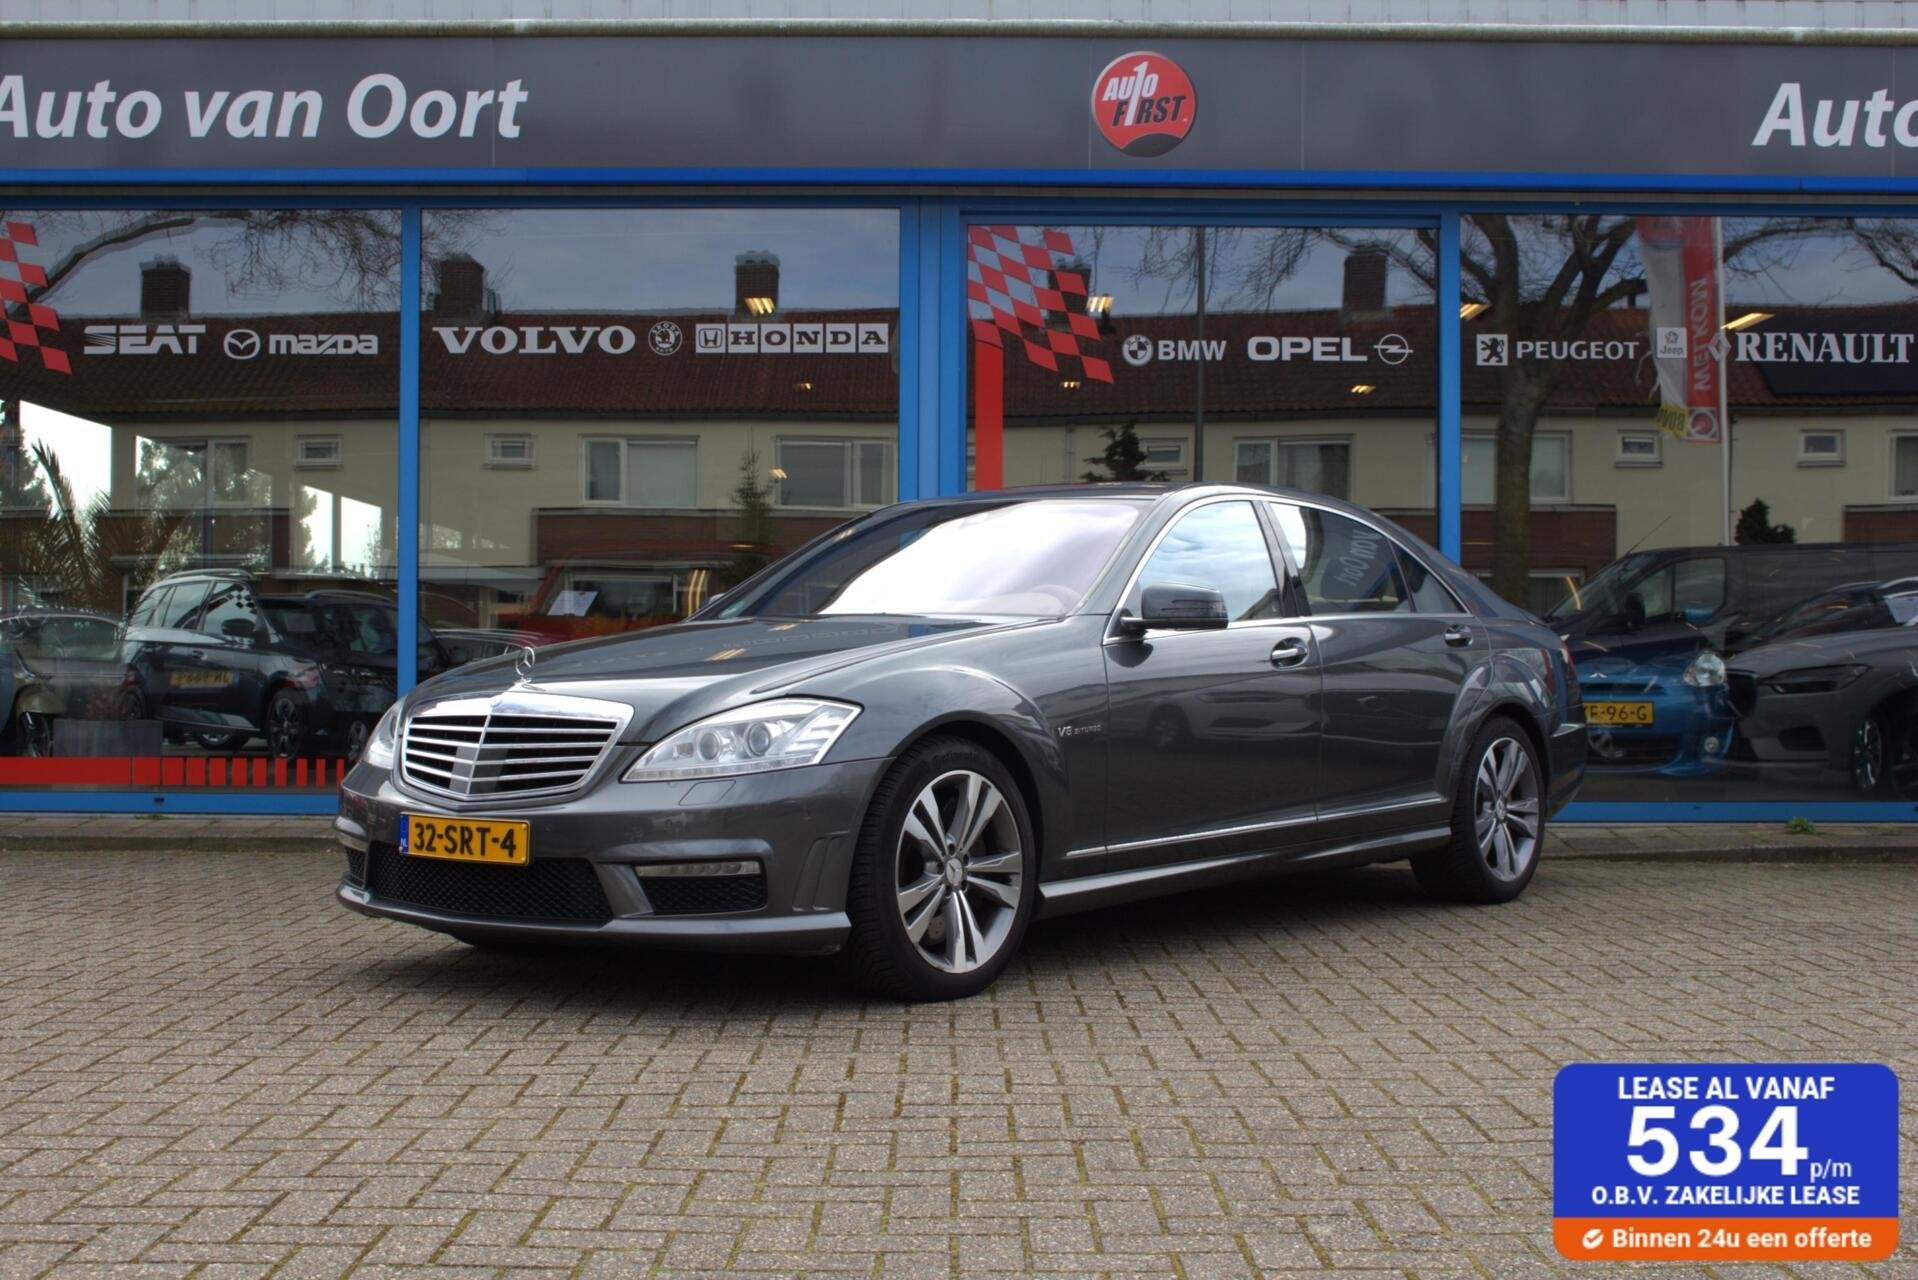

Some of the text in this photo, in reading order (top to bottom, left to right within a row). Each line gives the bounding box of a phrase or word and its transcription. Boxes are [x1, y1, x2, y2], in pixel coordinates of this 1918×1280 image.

[0, 73, 529, 139] Auto van Oort
[84, 325, 206, 355] SEAT
[432, 326, 636, 354] VOLVO
[729, 329, 887, 348] HONDA
[1158, 340, 1227, 361] BMW
[1247, 337, 1368, 362] OPEL
[1517, 340, 1640, 360] PEUGEOT
[1736, 332, 1914, 363] RENAULT
[414, 822, 517, 858] 32-SRT-4
